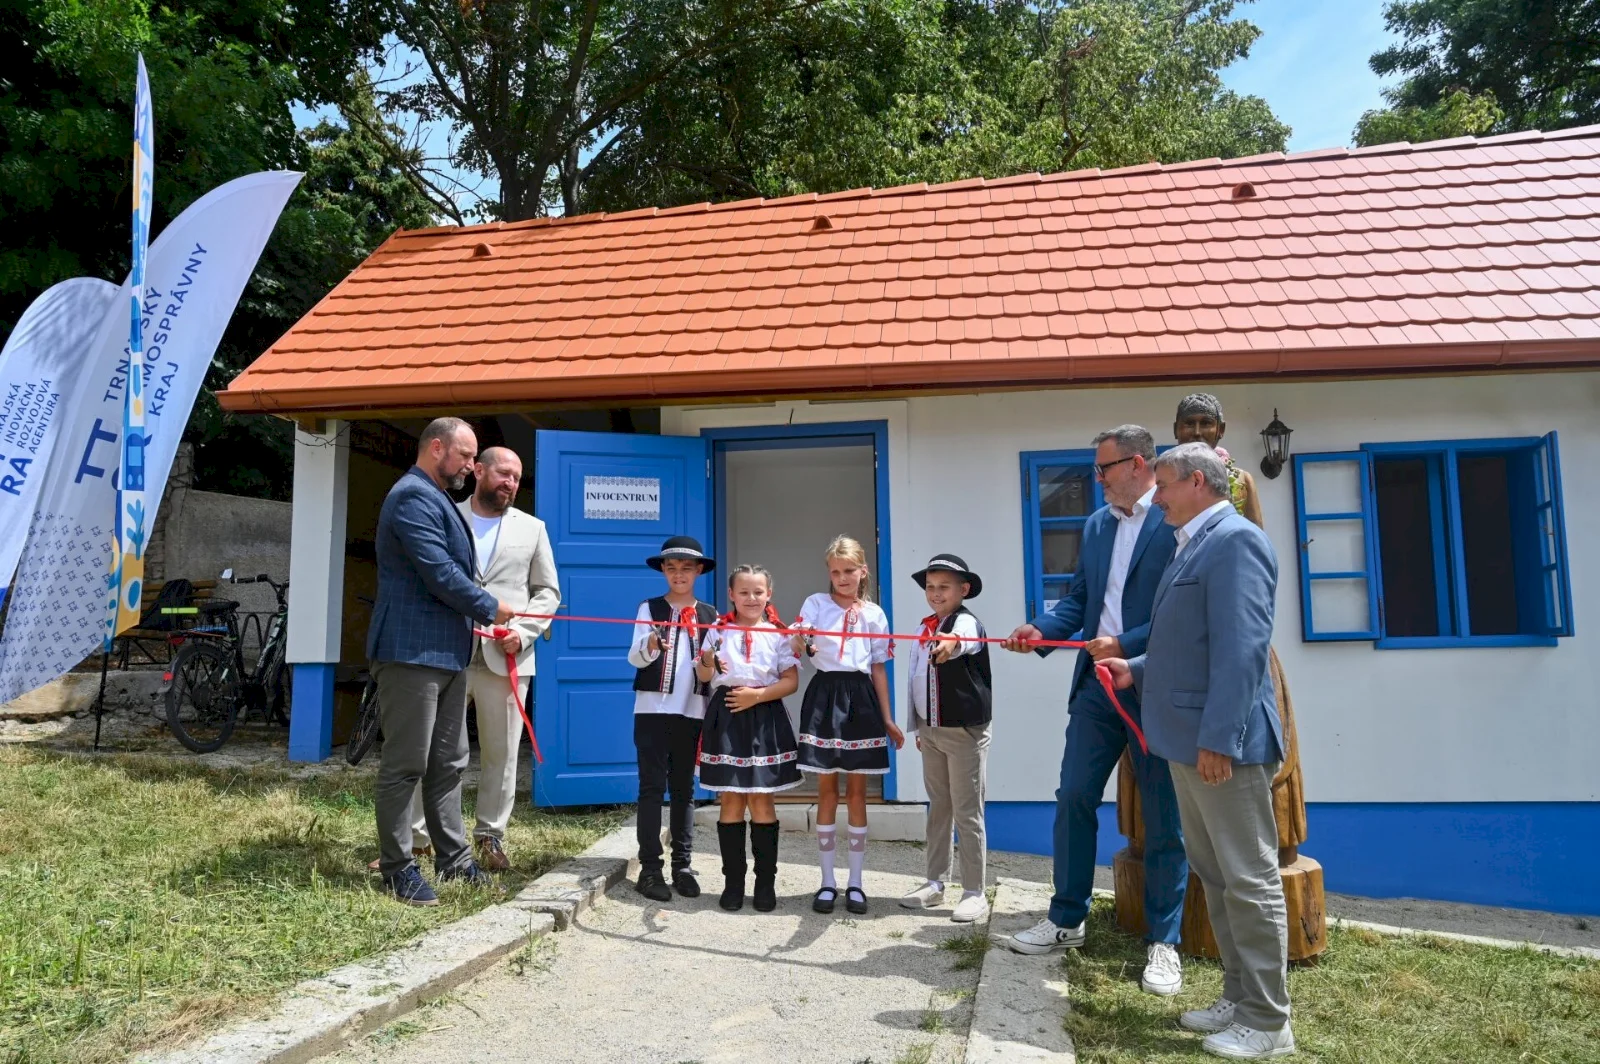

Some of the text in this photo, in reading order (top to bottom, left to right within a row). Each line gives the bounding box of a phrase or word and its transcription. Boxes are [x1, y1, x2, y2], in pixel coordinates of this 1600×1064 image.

[104, 287, 162, 403] TRNSKÝ
[143, 243, 207, 388] MOSPRÁVNY
[4, 382, 37, 444] INOVAČNÁ
[16, 378, 52, 449] ROZVOJOVÁ
[149, 361, 179, 416] KRAJ
[28, 392, 60, 455] AGENTÚRA
[586, 492, 658, 502] INFOCENTRUM
